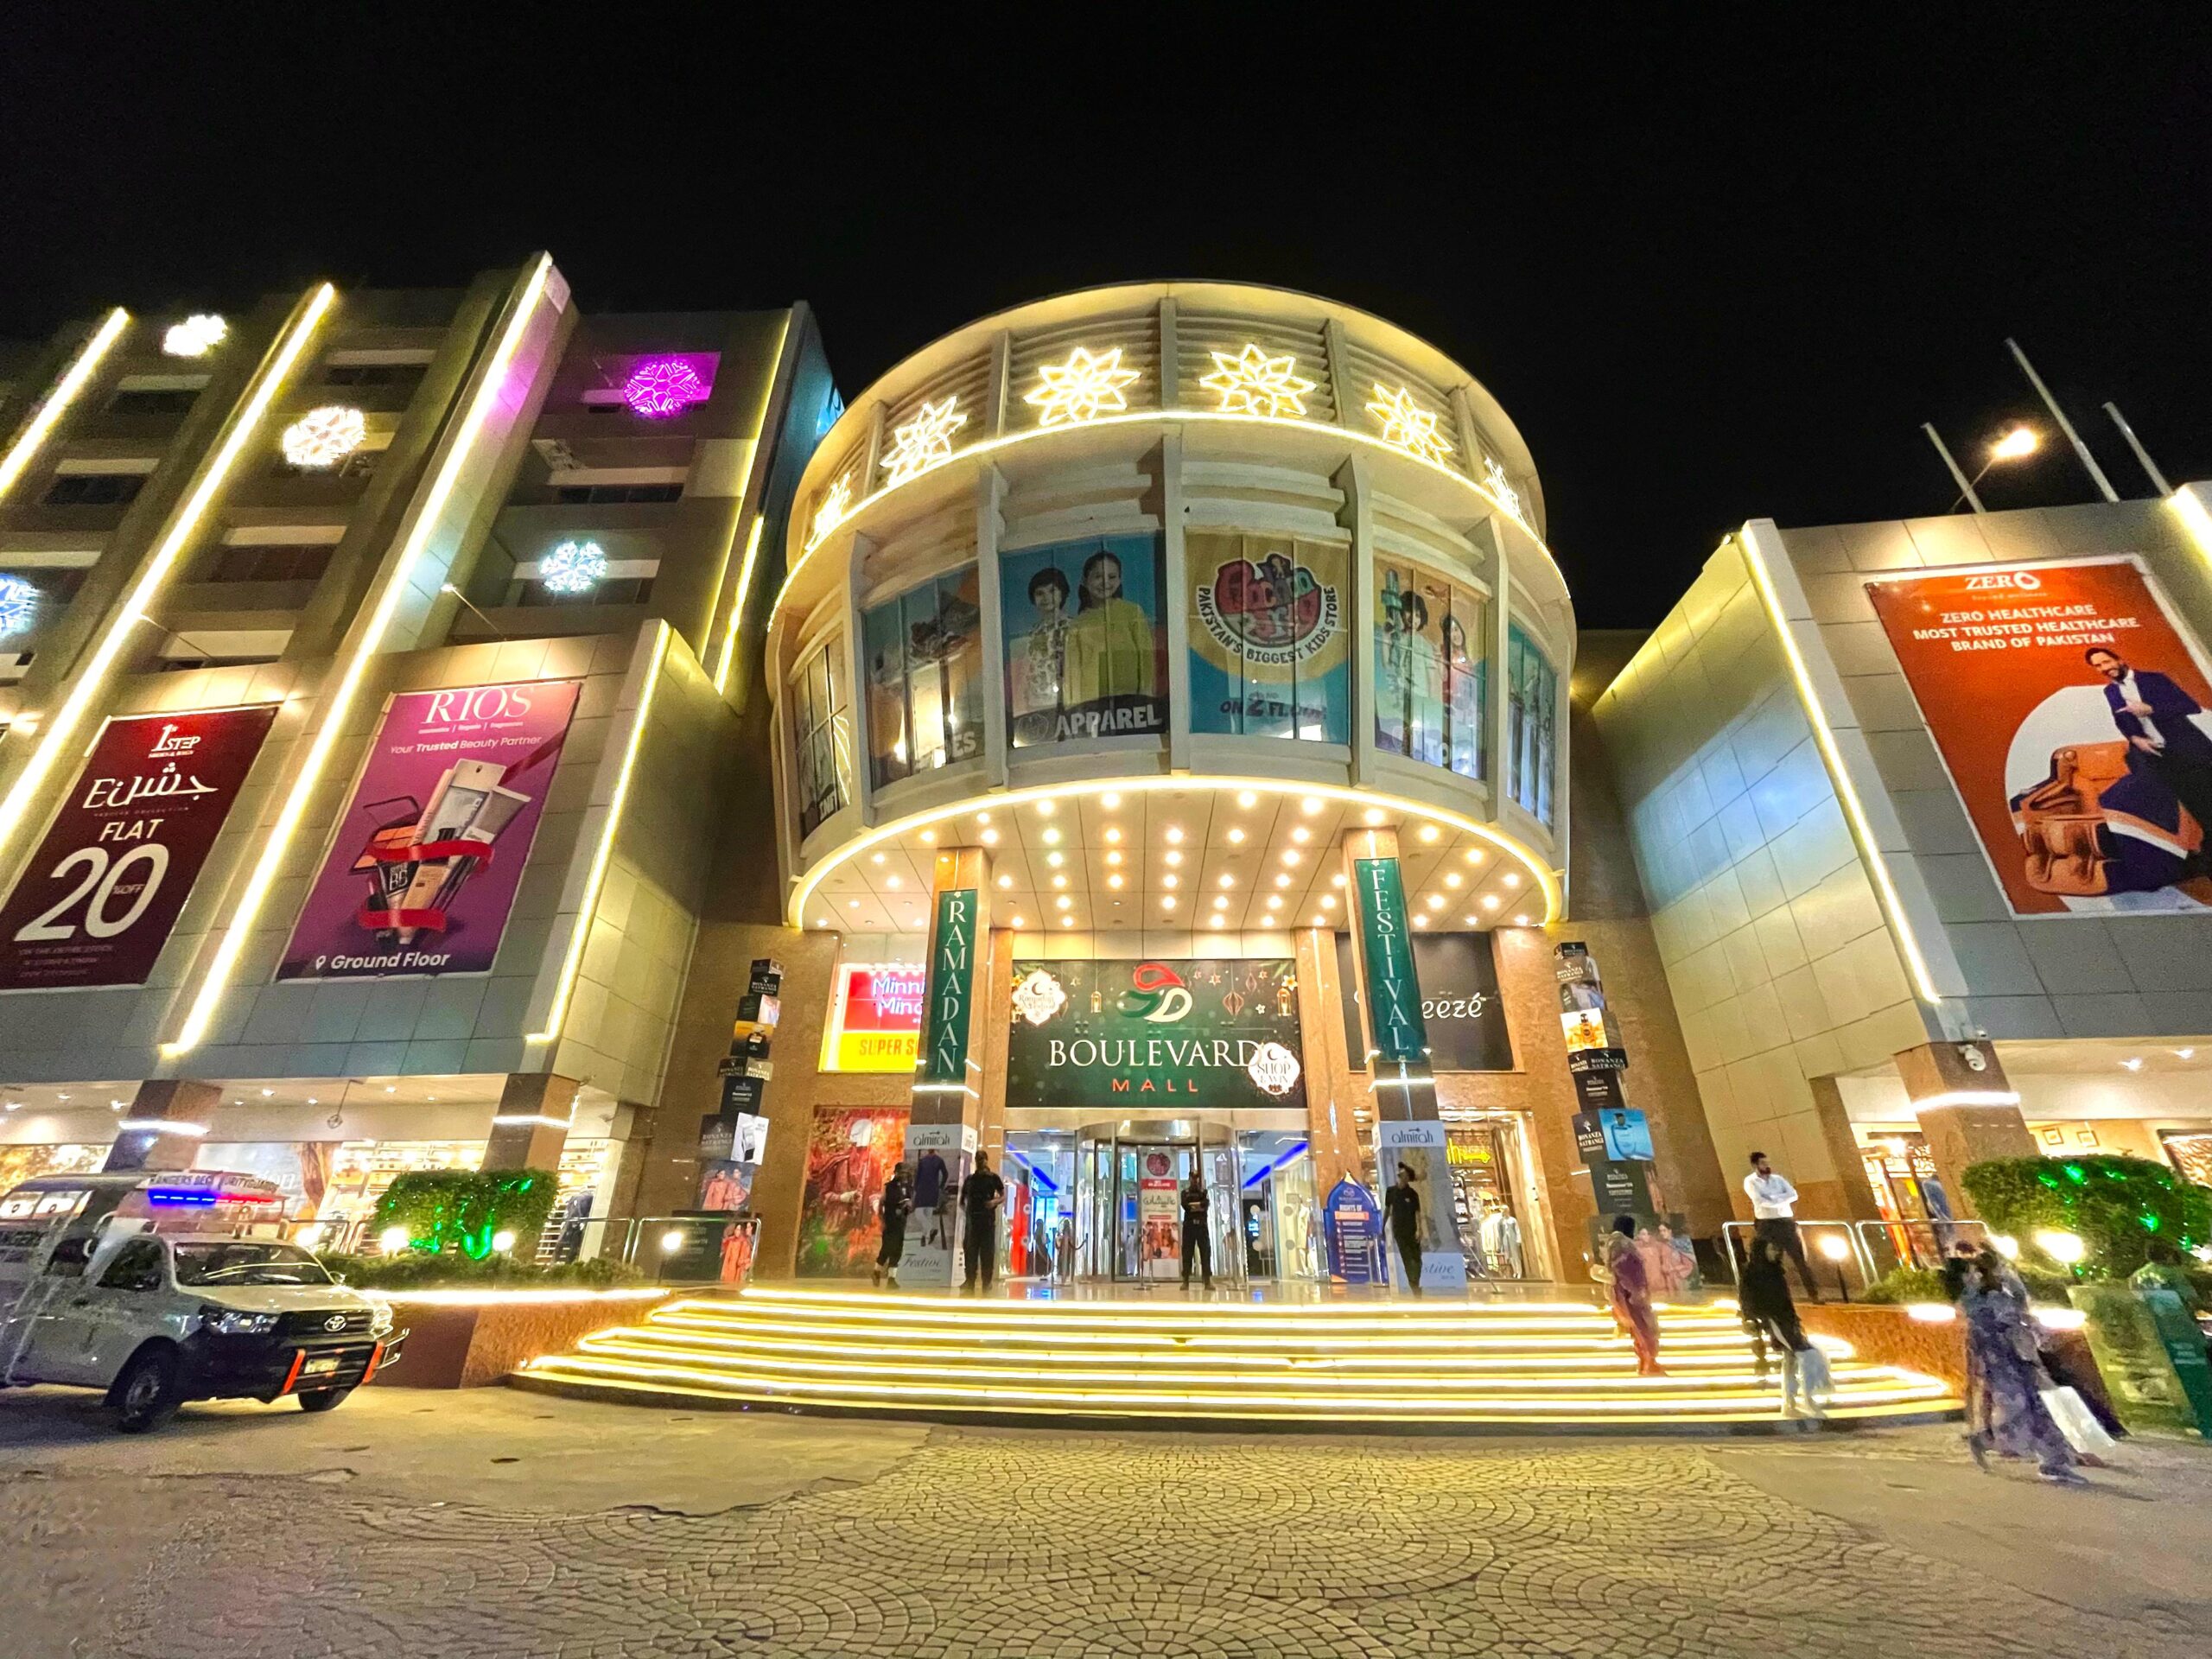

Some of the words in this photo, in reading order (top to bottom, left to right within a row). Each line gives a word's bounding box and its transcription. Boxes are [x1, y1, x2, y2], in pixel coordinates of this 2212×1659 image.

[1964, 571, 2041, 590] ZERO
[1940, 611, 1985, 624] ZERO
[1988, 604, 2098, 621] HEALTHCARE
[1198, 587, 1243, 654] PAKISTAN'S
[1246, 648, 1304, 664] BIGGEST
[1307, 626, 1331, 654] KIDS
[1323, 587, 1338, 627] STORE
[1912, 627, 1959, 640] MOST
[1961, 623, 2033, 638] TRUSTED
[2036, 617, 2141, 632] HEALTHCARE
[1950, 639, 2007, 652] BRAND
[2011, 636, 2032, 648] OF
[2036, 632, 2115, 647] PAKISTAN
[420, 686, 534, 724] RIOS
[1055, 703, 1163, 736] APPAREL
[391, 745, 414, 754] Your
[416, 741, 459, 753] Trusted
[460, 739, 498, 749] Beauty
[500, 735, 543, 747] Partner
[98, 819, 164, 842] FLAT
[14, 843, 169, 941] 20
[330, 952, 400, 970] Ground
[403, 950, 451, 967] Floor
[1370, 869, 1409, 1052] FESTIVAL
[872, 976, 925, 997] Minni
[938, 900, 967, 1073] RAMADAN
[878, 997, 922, 1018] Mino
[859, 1039, 902, 1056] SUPER
[1048, 1039, 1262, 1067] BOULEVARD
[1257, 1063, 1291, 1075] SHOP
[1112, 1078, 1198, 1092] MALL
[913, 1133, 950, 1146] almirah
[1392, 1129, 1433, 1143] almirah
